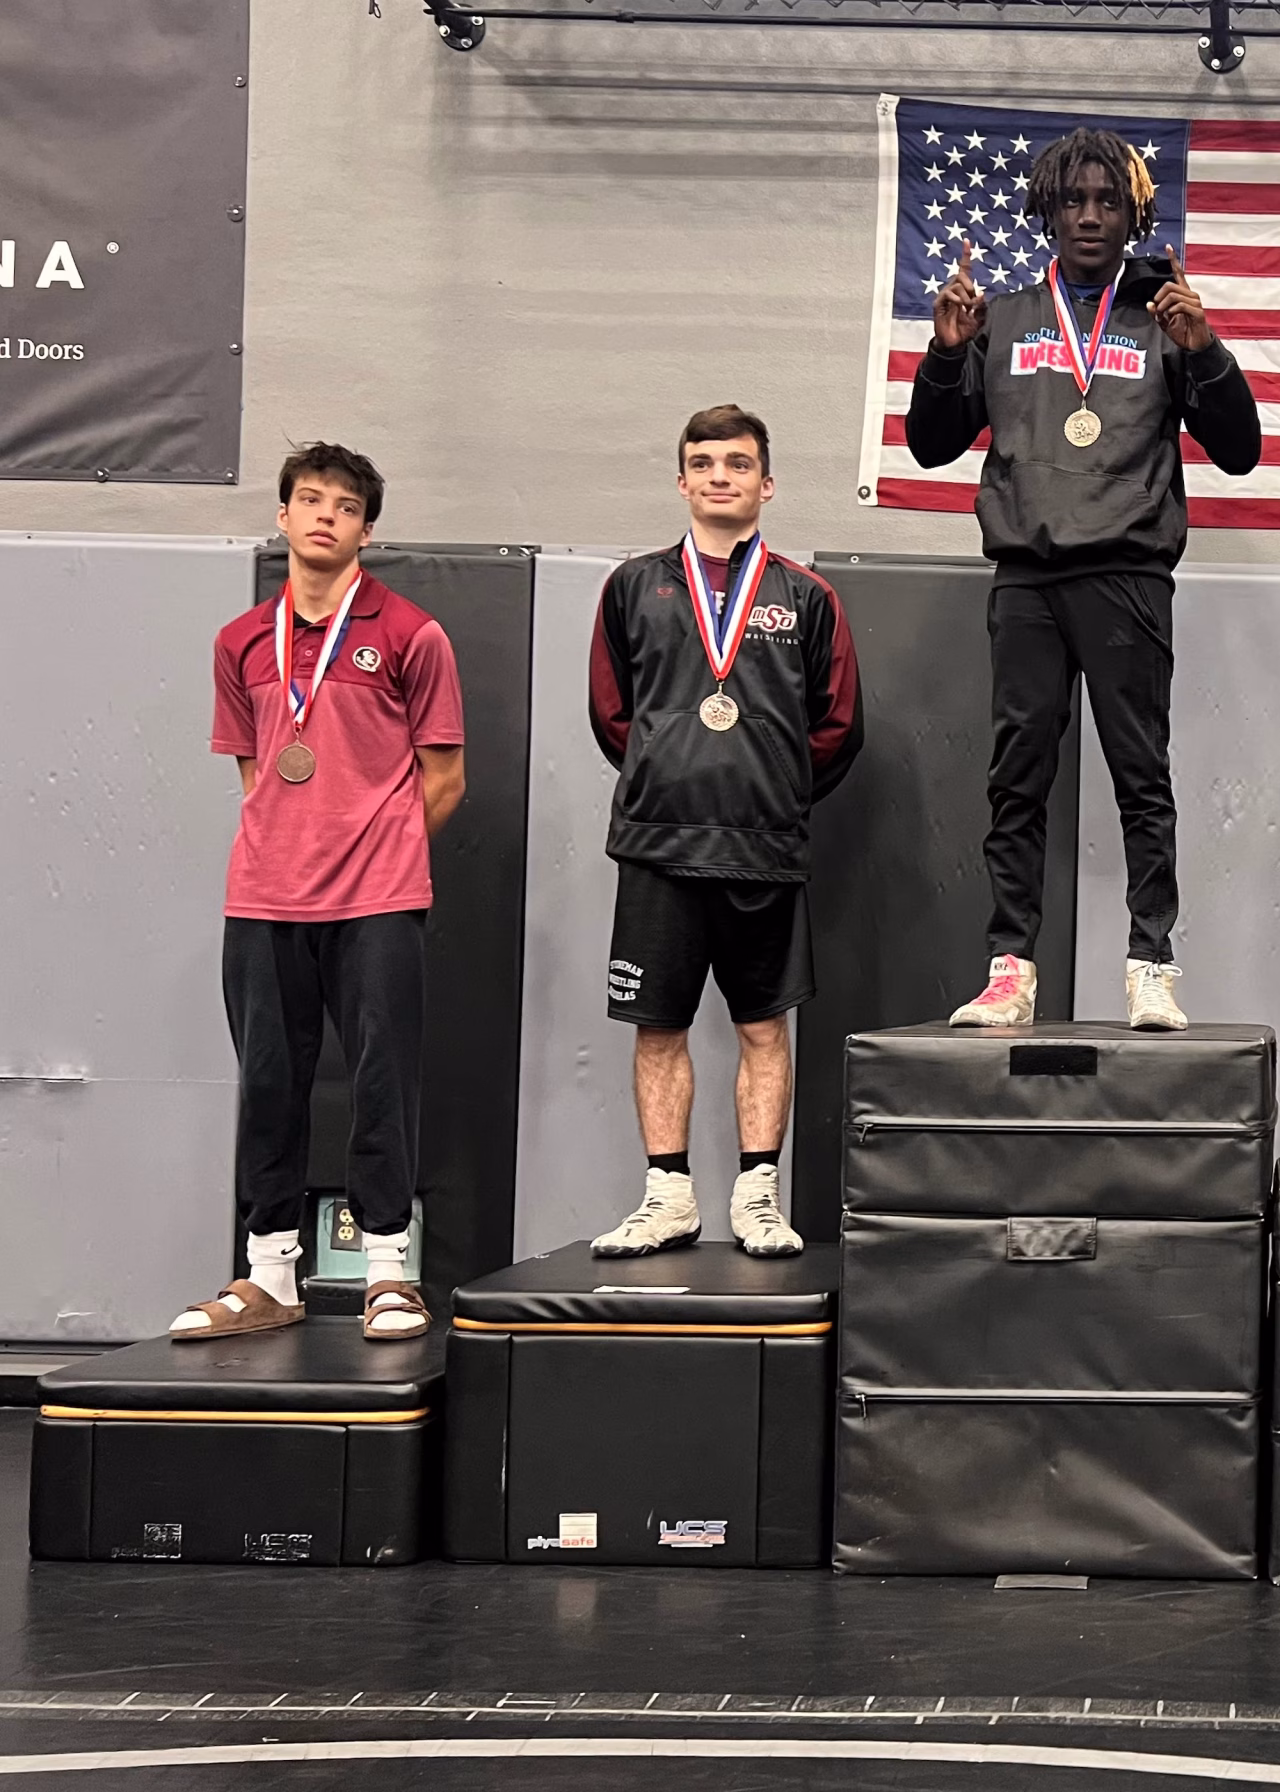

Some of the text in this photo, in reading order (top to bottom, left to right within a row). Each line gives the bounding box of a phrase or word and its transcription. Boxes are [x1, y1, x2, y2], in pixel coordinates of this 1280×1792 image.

[18, 338, 84, 360] Doors
[1019, 342, 1139, 373] WRESING
[660, 1520, 729, 1537] UCS
